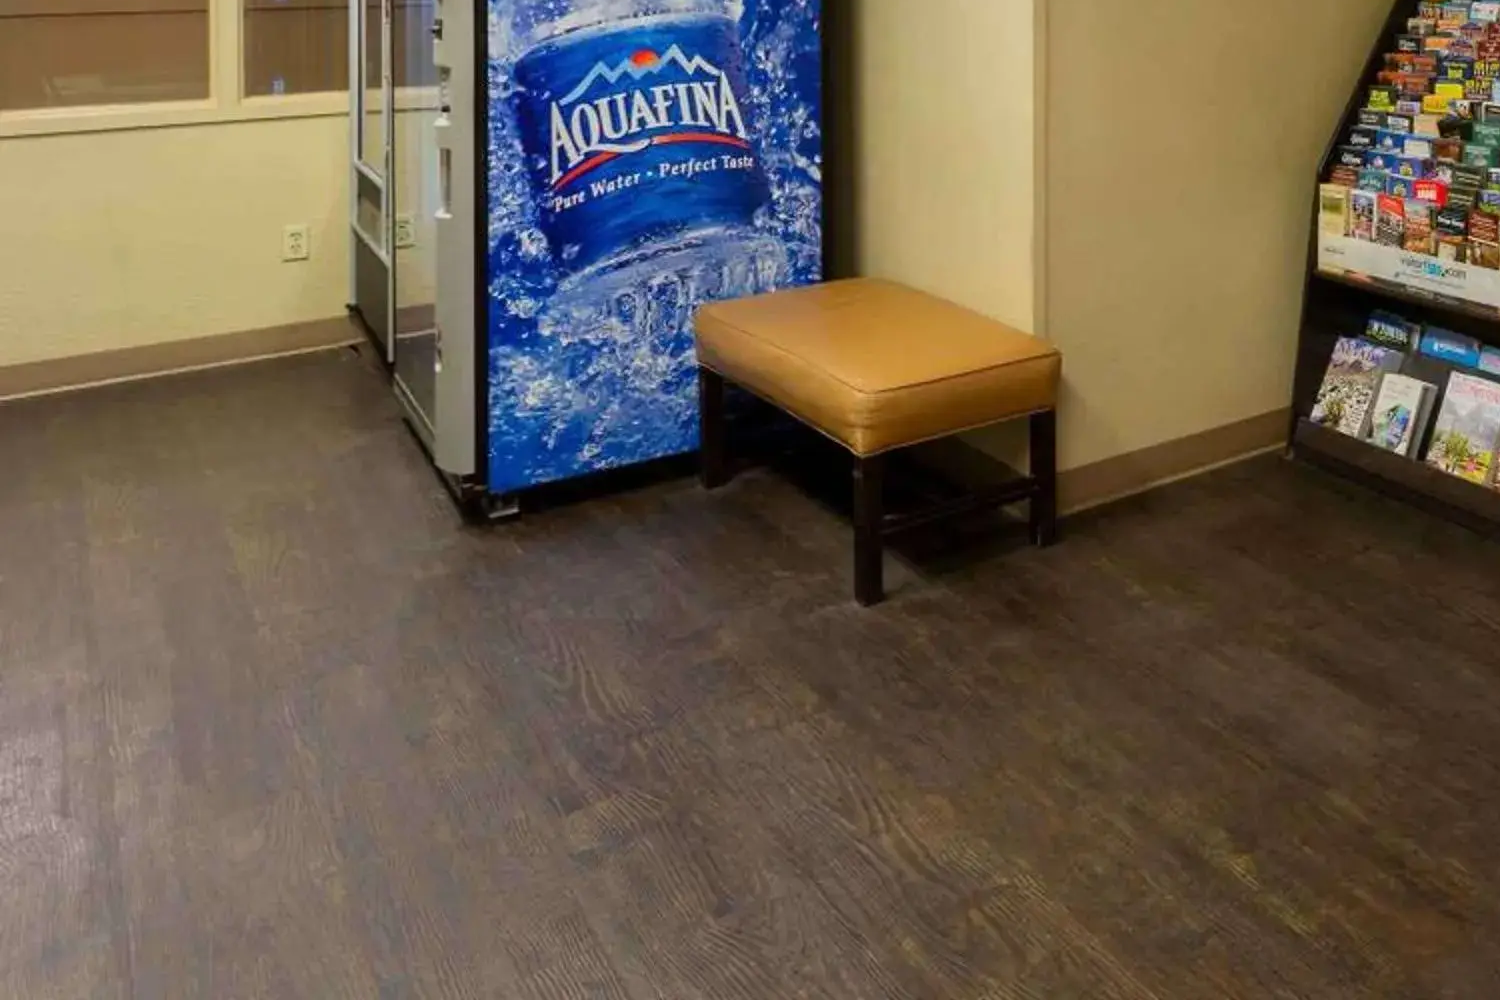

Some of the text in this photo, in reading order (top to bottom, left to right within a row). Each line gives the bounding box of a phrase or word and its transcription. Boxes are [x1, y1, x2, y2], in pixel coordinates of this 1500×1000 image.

[550, 72, 747, 187] AQUAFINA
[553, 154, 755, 213] Pure Water Perfect Taste
